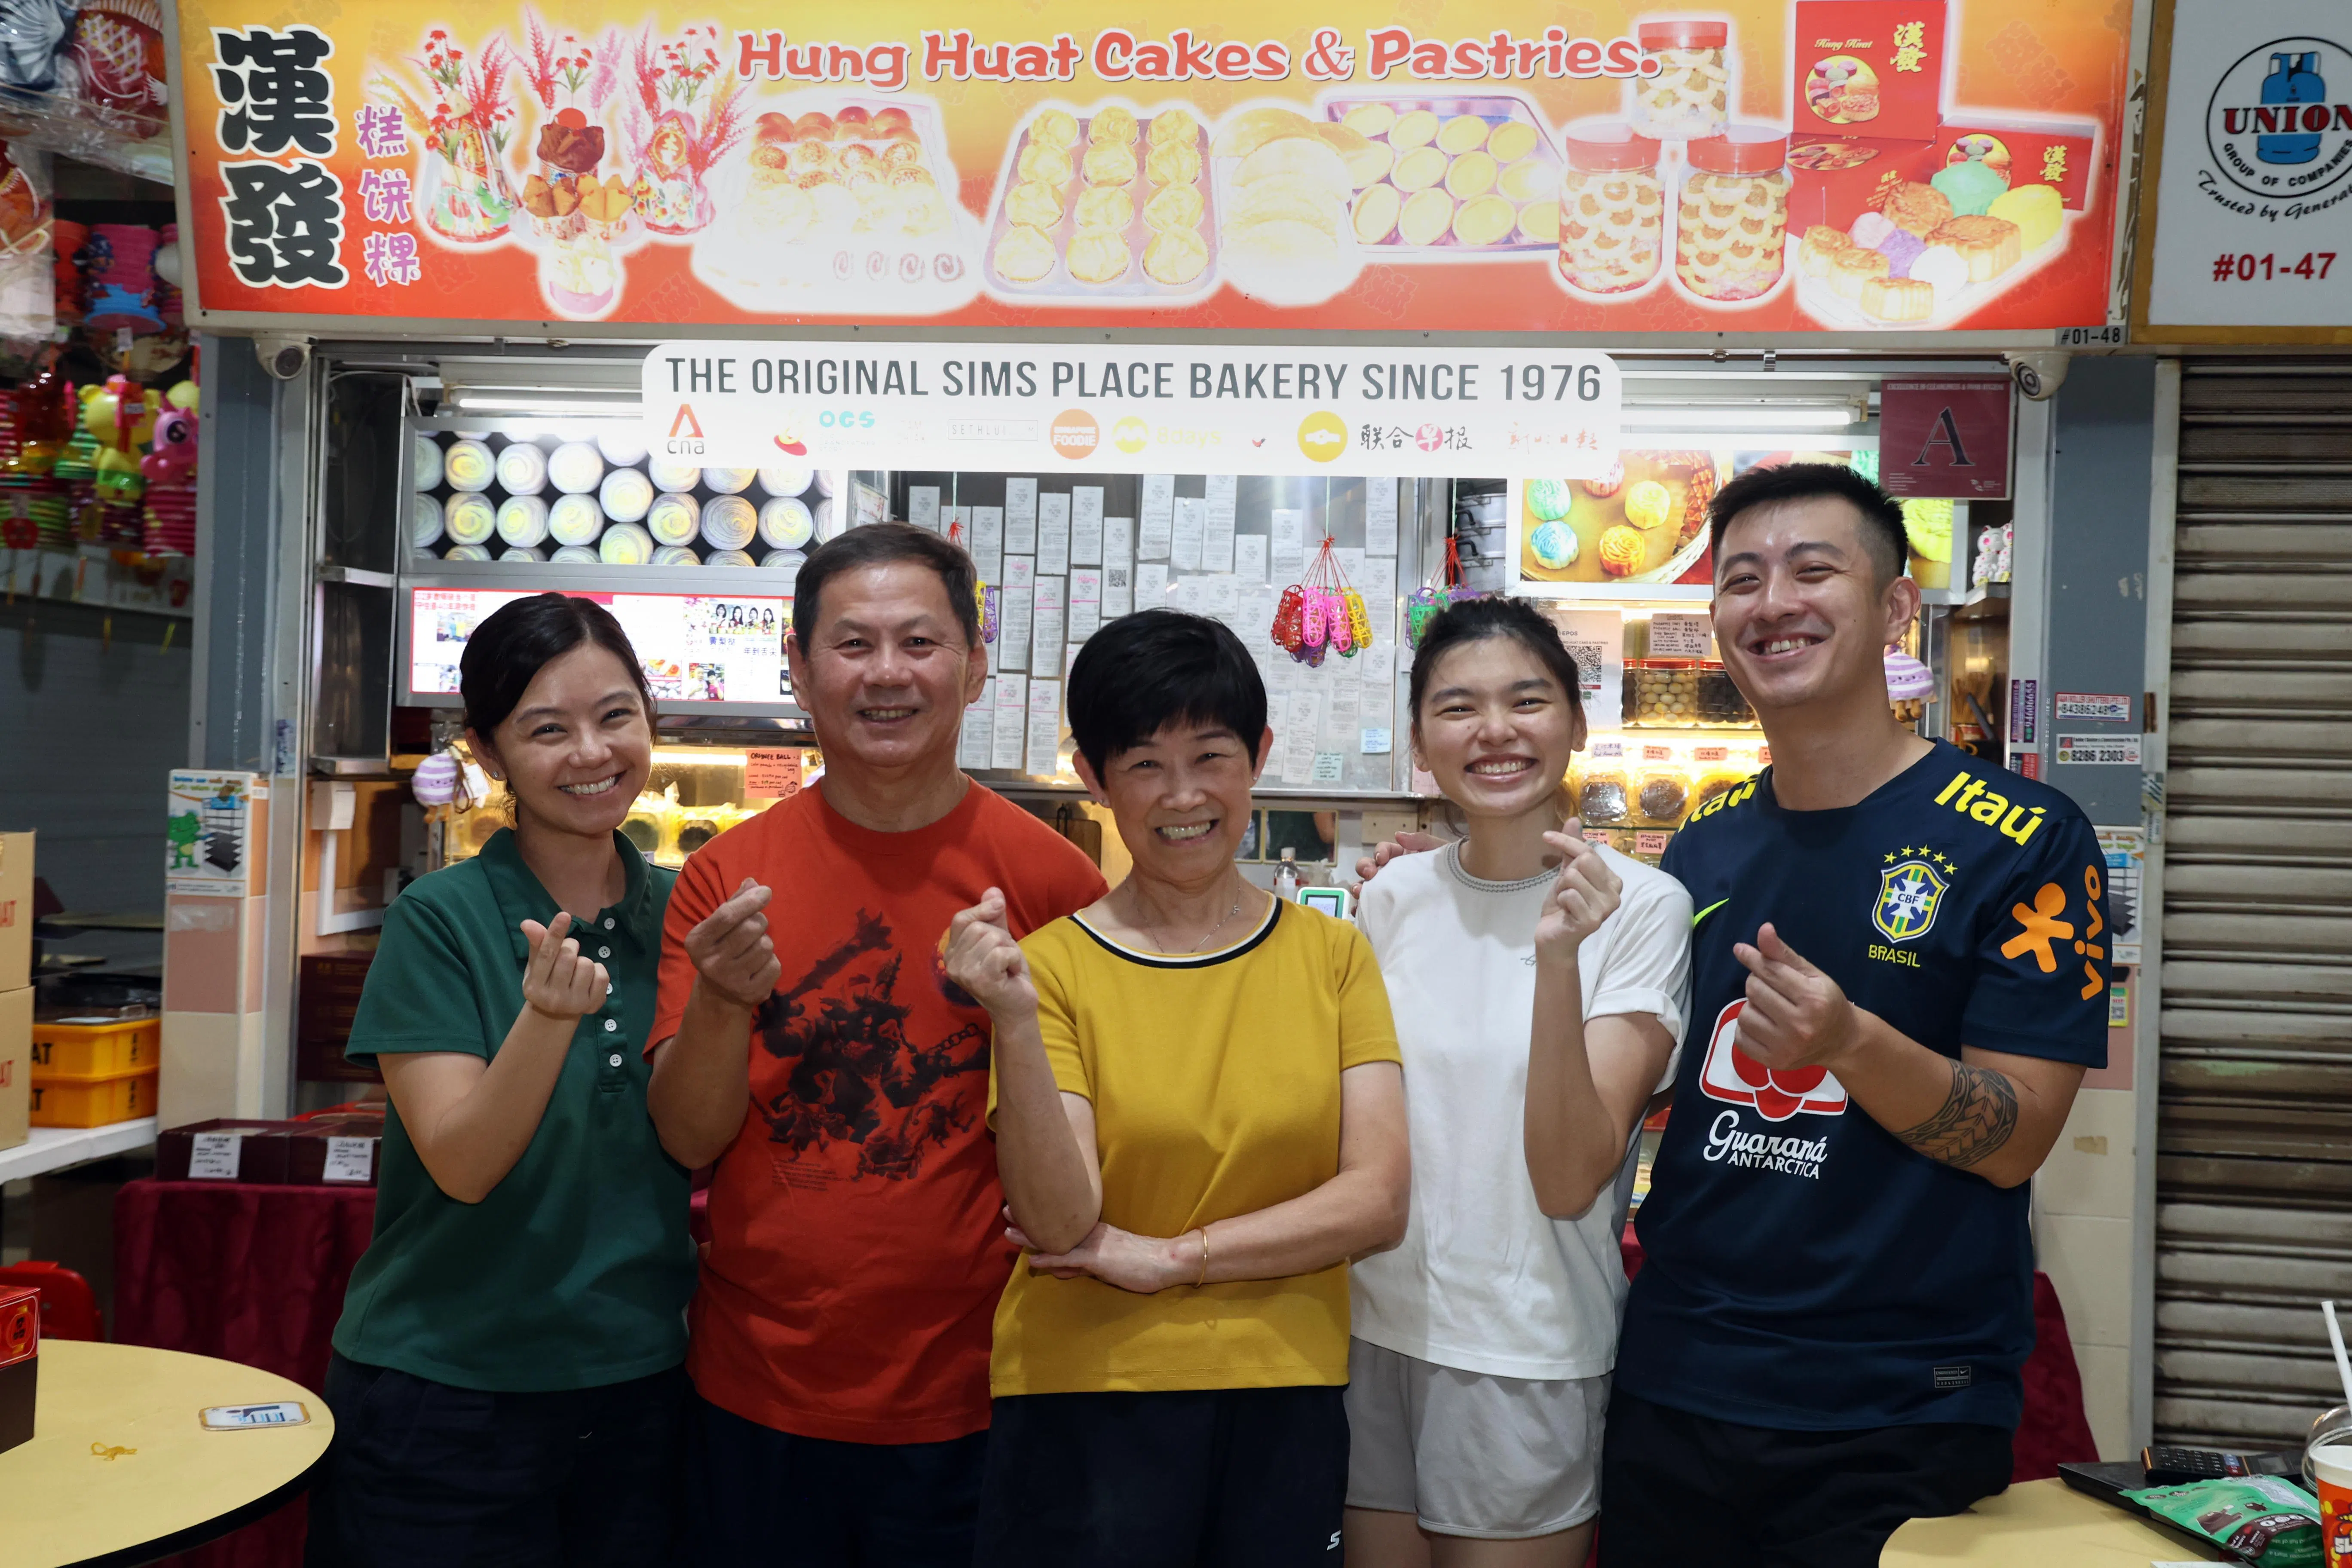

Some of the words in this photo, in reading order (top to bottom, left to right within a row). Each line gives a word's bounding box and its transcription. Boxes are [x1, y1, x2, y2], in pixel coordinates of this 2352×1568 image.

[738, 30, 908, 88] Hung
[923, 30, 1081, 80] Huat
[1095, 28, 1289, 80] Cakes
[1304, 38, 1353, 79] &
[1369, 28, 1661, 79] Pastries.
[2223, 104, 2352, 135] UNION
[214, 26, 348, 288] 漢發
[2224, 142, 2255, 177] GROUP
[2261, 175, 2279, 187] OF
[2288, 139, 2352, 187] COMPANIES
[2198, 170, 2255, 214] Trusted
[2260, 205, 2280, 222] by
[2214, 253, 2337, 282] #01-47
[2060, 327, 2122, 346] #01-48
[665, 358, 737, 393] THE
[752, 358, 928, 396] ORIGINAL
[943, 360, 1037, 398] SIMS
[1053, 362, 1174, 399] PLACE
[1190, 363, 1348, 400] BAKERY
[1362, 364, 1479, 401] SINCE
[1500, 365, 1601, 401] 1976
[667, 439, 704, 455] cna
[1053, 435, 1096, 446] FOODIE
[1157, 426, 1221, 449] 8days
[1911, 406, 1976, 466] A
[1934, 770, 2047, 846] Itaú
[1897, 893, 1920, 905] CBF
[2074, 864, 2104, 1001] vivo
[1868, 944, 1921, 968] BRASIL
[1703, 1109, 1829, 1164] Guaraná
[1726, 1151, 1820, 1180] ANTARCTICA
